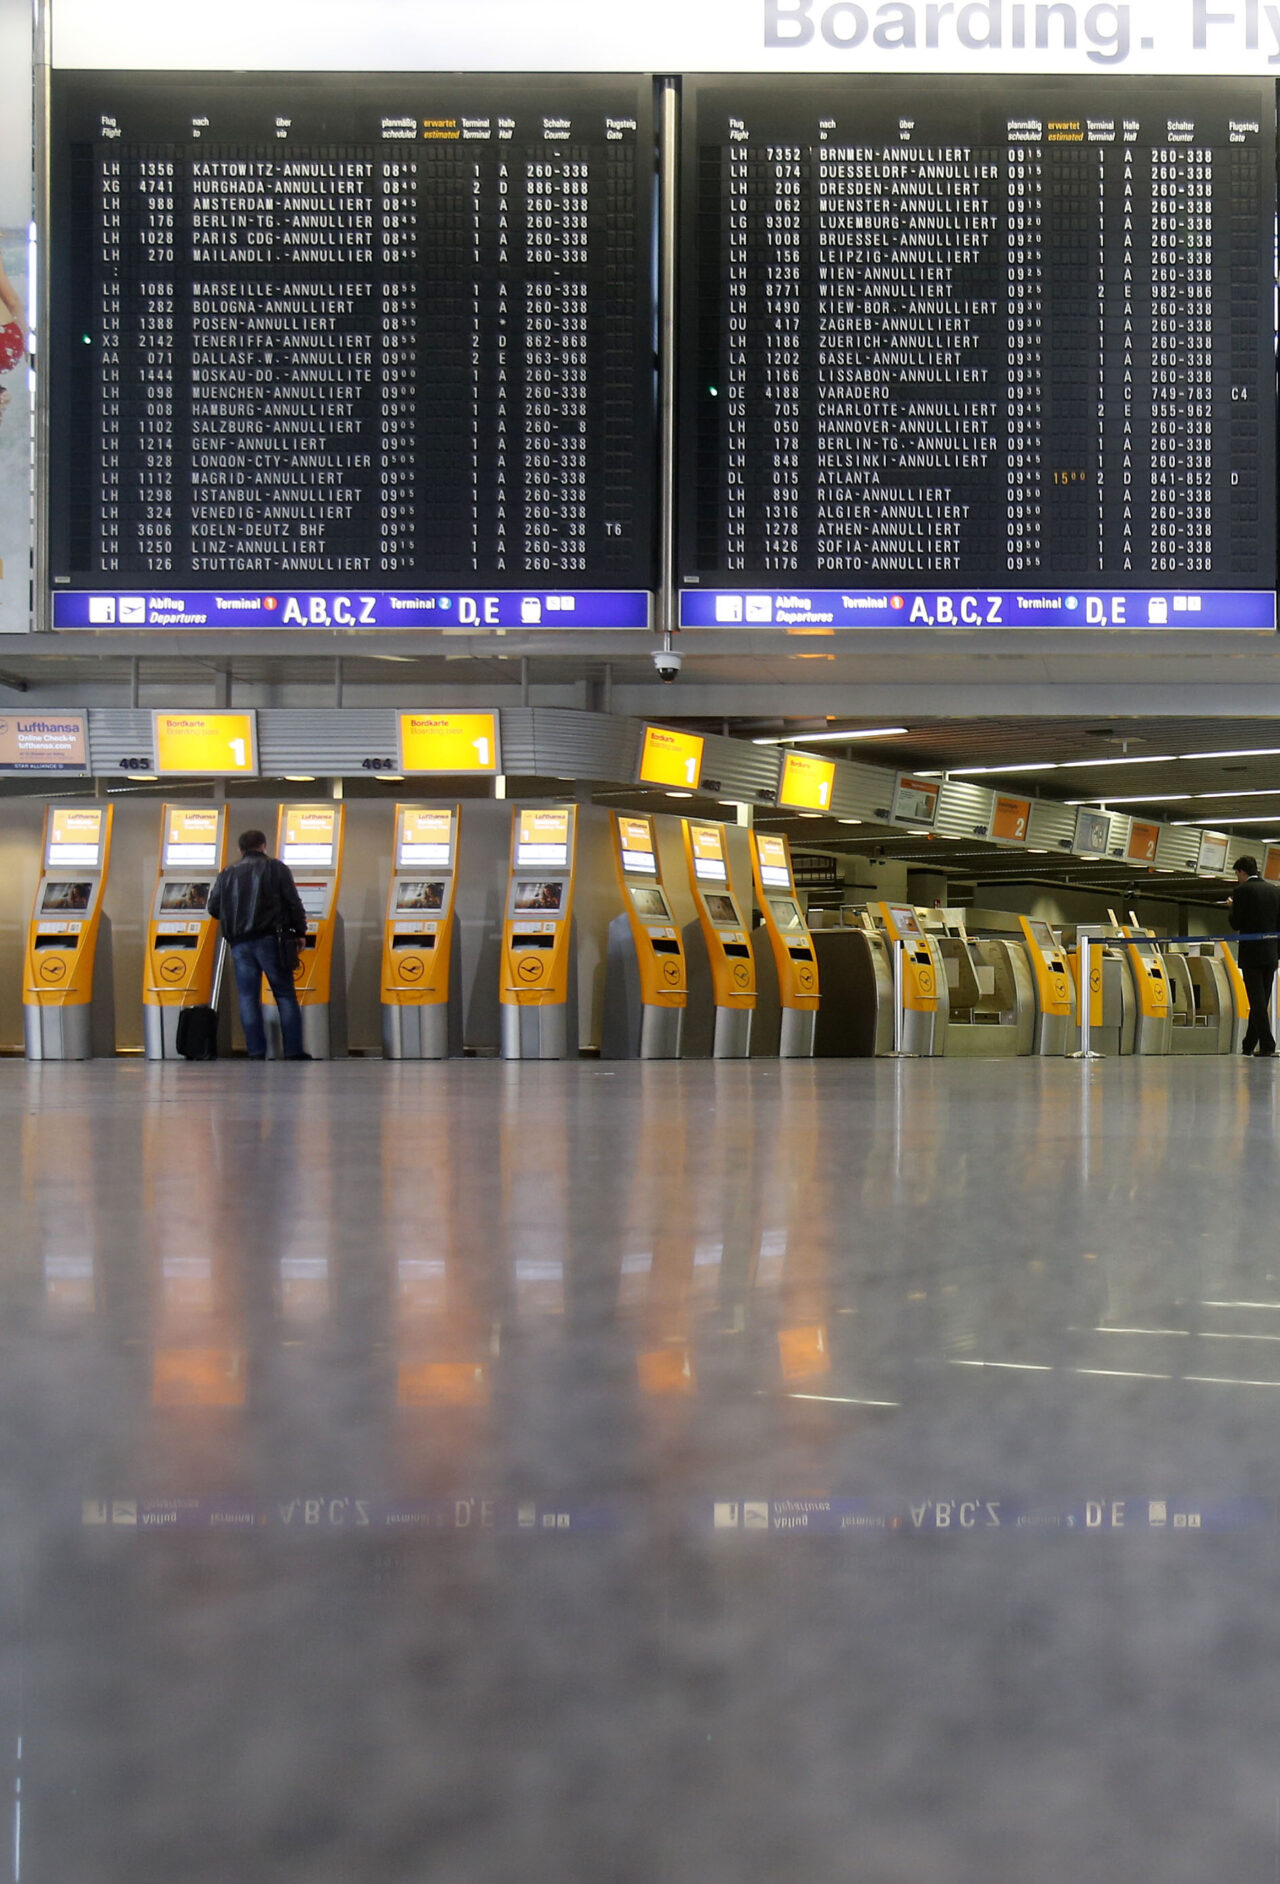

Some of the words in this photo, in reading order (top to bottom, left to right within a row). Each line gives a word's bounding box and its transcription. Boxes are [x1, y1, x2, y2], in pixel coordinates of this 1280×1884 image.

[764, 0, 1154, 65] Boarding.
[101, 116, 117, 127] Flug
[192, 117, 210, 127] nach
[275, 117, 292, 127] über
[423, 119, 457, 128] erwartet
[461, 118, 490, 128] Terminal
[498, 118, 516, 128] Halle
[543, 118, 571, 129] Schalter
[606, 118, 637, 131] Flugsteig
[101, 127, 122, 139] Flight
[382, 130, 417, 140] scheduled
[423, 130, 461, 140] estimated
[462, 130, 492, 140] Terminal
[498, 130, 513, 140] Hall
[543, 130, 571, 140] Counter
[606, 131, 623, 140] Gate
[103, 162, 120, 176] LH
[140, 163, 174, 176] 1356
[193, 163, 373, 177] KATTOWITZ-ANNULLIERT
[527, 164, 588, 178] 260-338
[103, 179, 120, 193] XG
[139, 180, 173, 193] 4741
[193, 180, 364, 194] HURGHADA-ANNULLIERT
[527, 181, 588, 195] 886-888
[730, 215, 747, 229] LG
[766, 215, 800, 229] 9302
[820, 215, 996, 230] LUXEMBURG-ANNULLIERT
[1151, 217, 1212, 231] 260-338
[102, 334, 119, 347] X3
[139, 334, 173, 348] 2142
[193, 334, 370, 348] TENERIFFA-ANNULLIERT
[526, 334, 587, 348] 862-868
[728, 386, 745, 399] DE
[765, 385, 799, 399] 4188
[818, 385, 889, 399] VARADERO
[1152, 386, 1212, 400] 749-783
[1231, 387, 1248, 401] C4
[728, 402, 746, 416] US
[774, 403, 799, 416] 705
[818, 402, 997, 416] CHARLOTTE-ANNULLIERT
[1151, 403, 1212, 417] 955-962
[101, 523, 118, 536] LH
[137, 523, 172, 536] 3606
[191, 523, 290, 537] KOELN-DEUTZ
[299, 523, 325, 536] BHF
[605, 522, 622, 536] T6
[765, 556, 798, 570] 1176
[817, 556, 961, 570] PORTO-ANNULLIERT
[1151, 557, 1212, 571] 260-338
[150, 597, 185, 612] Abflug
[776, 595, 812, 611] Abflug
[215, 597, 261, 610] Terminal
[390, 597, 436, 610] Terminal
[458, 596, 500, 627] D,E
[775, 611, 834, 625] Departures
[842, 596, 888, 609] Terminal
[1016, 596, 1062, 609] Terminal
[1085, 596, 1127, 627] D,E
[150, 612, 207, 626] Departures
[16, 721, 80, 734] Lufthansa
[166, 719, 205, 728] Bordkarte
[410, 719, 449, 727] Bordkarte
[17, 734, 43, 743] Online
[18, 742, 72, 751] lufthansa.com
[228, 738, 246, 767] 1
[472, 736, 489, 765] 1
[119, 758, 150, 771] 465
[361, 758, 393, 770] 464
[684, 757, 697, 784] 1
[817, 782, 829, 806] 1
[1014, 817, 1025, 837] 2
[1146, 840, 1156, 858] 2
